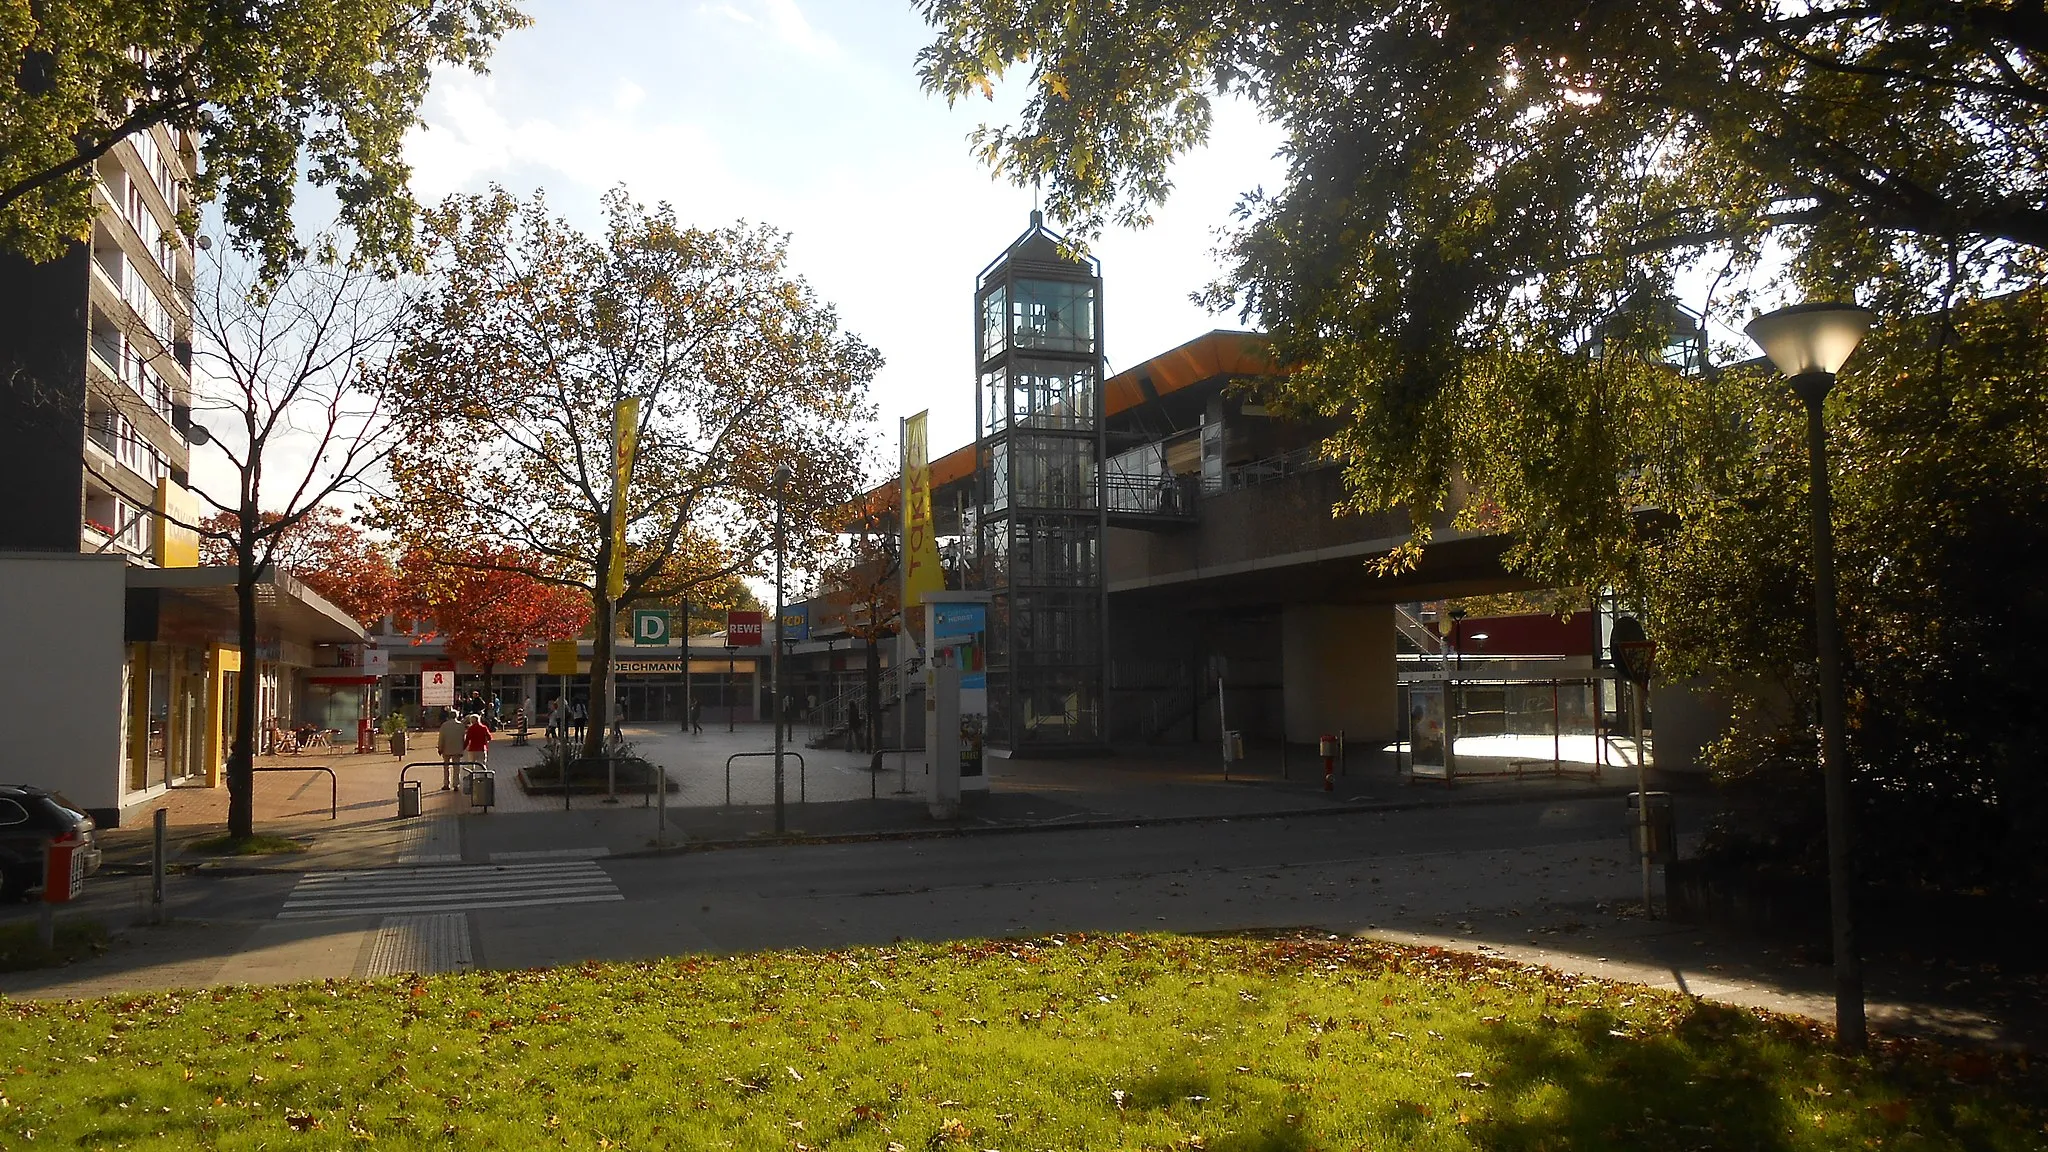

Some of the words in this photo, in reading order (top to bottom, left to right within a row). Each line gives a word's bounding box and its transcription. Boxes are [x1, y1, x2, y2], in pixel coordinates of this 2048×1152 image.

[641, 616, 665, 640] D
[729, 624, 761, 634] REWE
[614, 663, 682, 672] DEICHMANN
